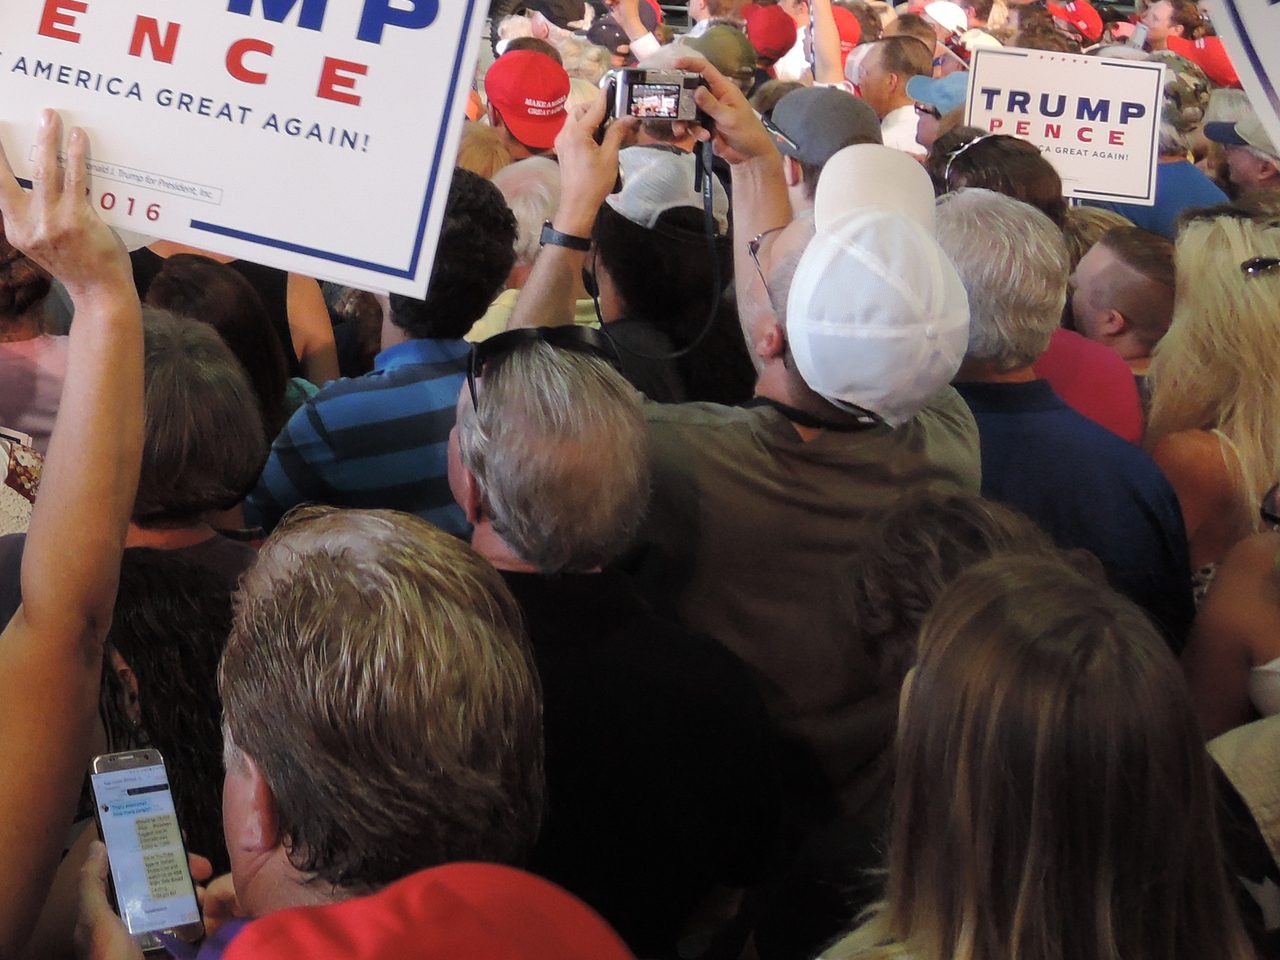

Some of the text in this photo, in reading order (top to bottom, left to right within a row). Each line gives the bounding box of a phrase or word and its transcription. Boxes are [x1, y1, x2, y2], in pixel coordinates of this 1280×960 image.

[11, 55, 143, 102] AMERICA
[156, 88, 253, 125] GREAT
[261, 112, 370, 153] AGAIN!
[980, 86, 1147, 125] TRUMP
[989, 118, 1126, 146] PENCE
[1055, 146, 1089, 157] GREAT
[1091, 151, 1129, 161] AGAIN!
[118, 169, 144, 183] Trump
